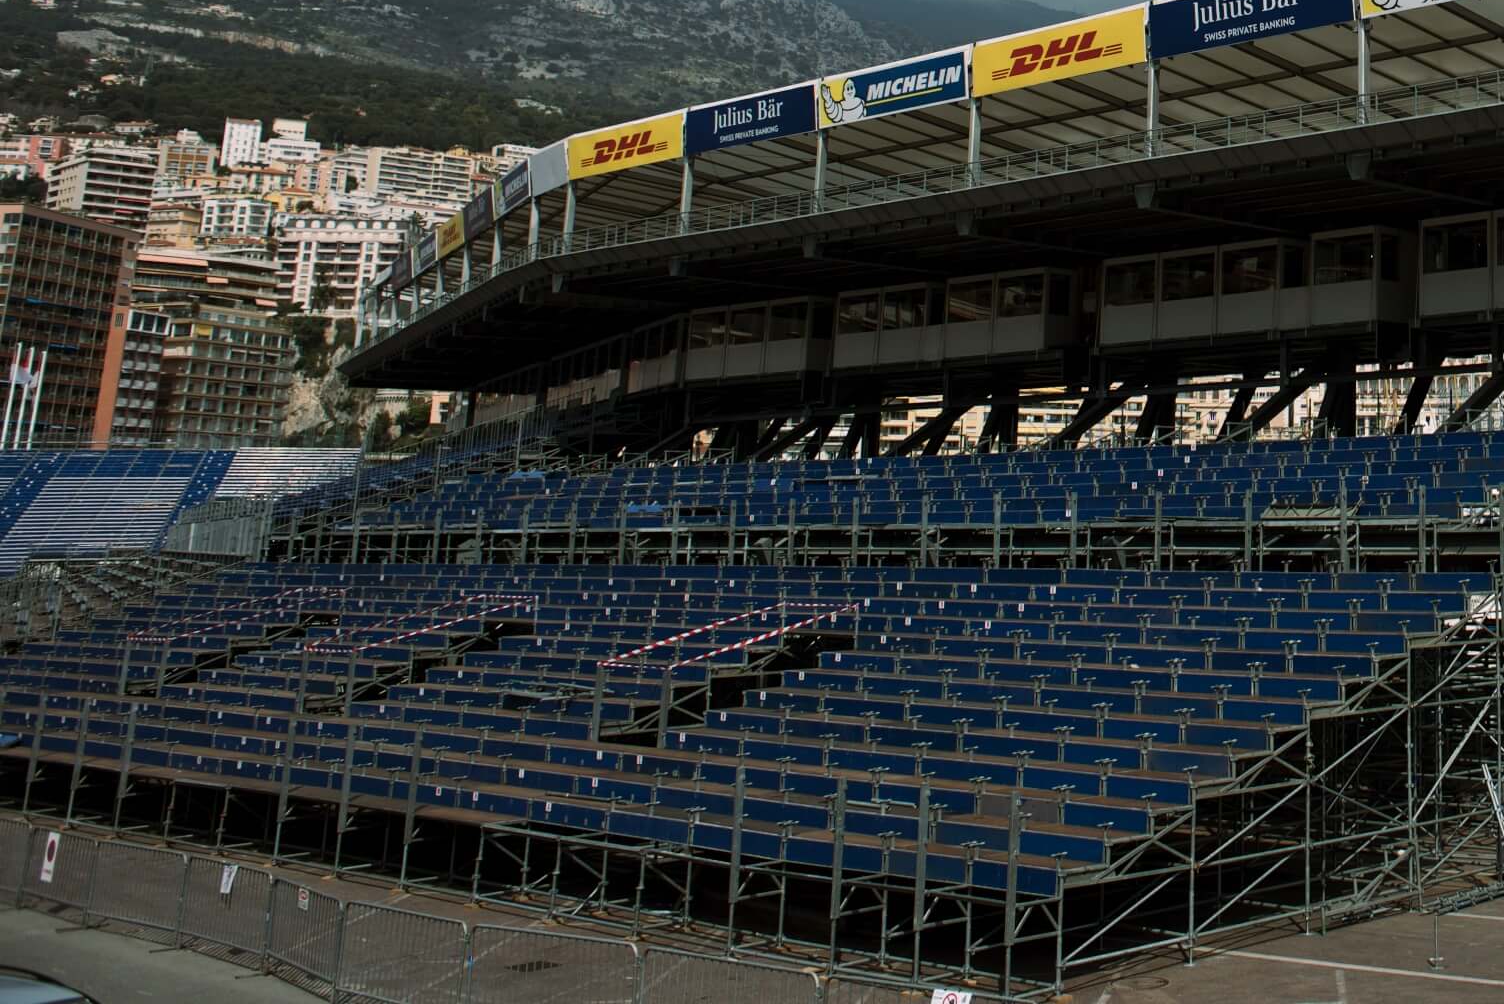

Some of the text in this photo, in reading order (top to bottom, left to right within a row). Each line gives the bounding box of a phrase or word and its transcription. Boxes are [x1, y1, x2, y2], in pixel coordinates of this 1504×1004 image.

[1204, 16, 1296, 42] SWISS PRIVATE BANKING
[1009, 30, 1104, 77] DHL
[866, 64, 962, 101] MICHELIN
[713, 98, 784, 134] Julius Bär
[593, 130, 656, 165] DHL
